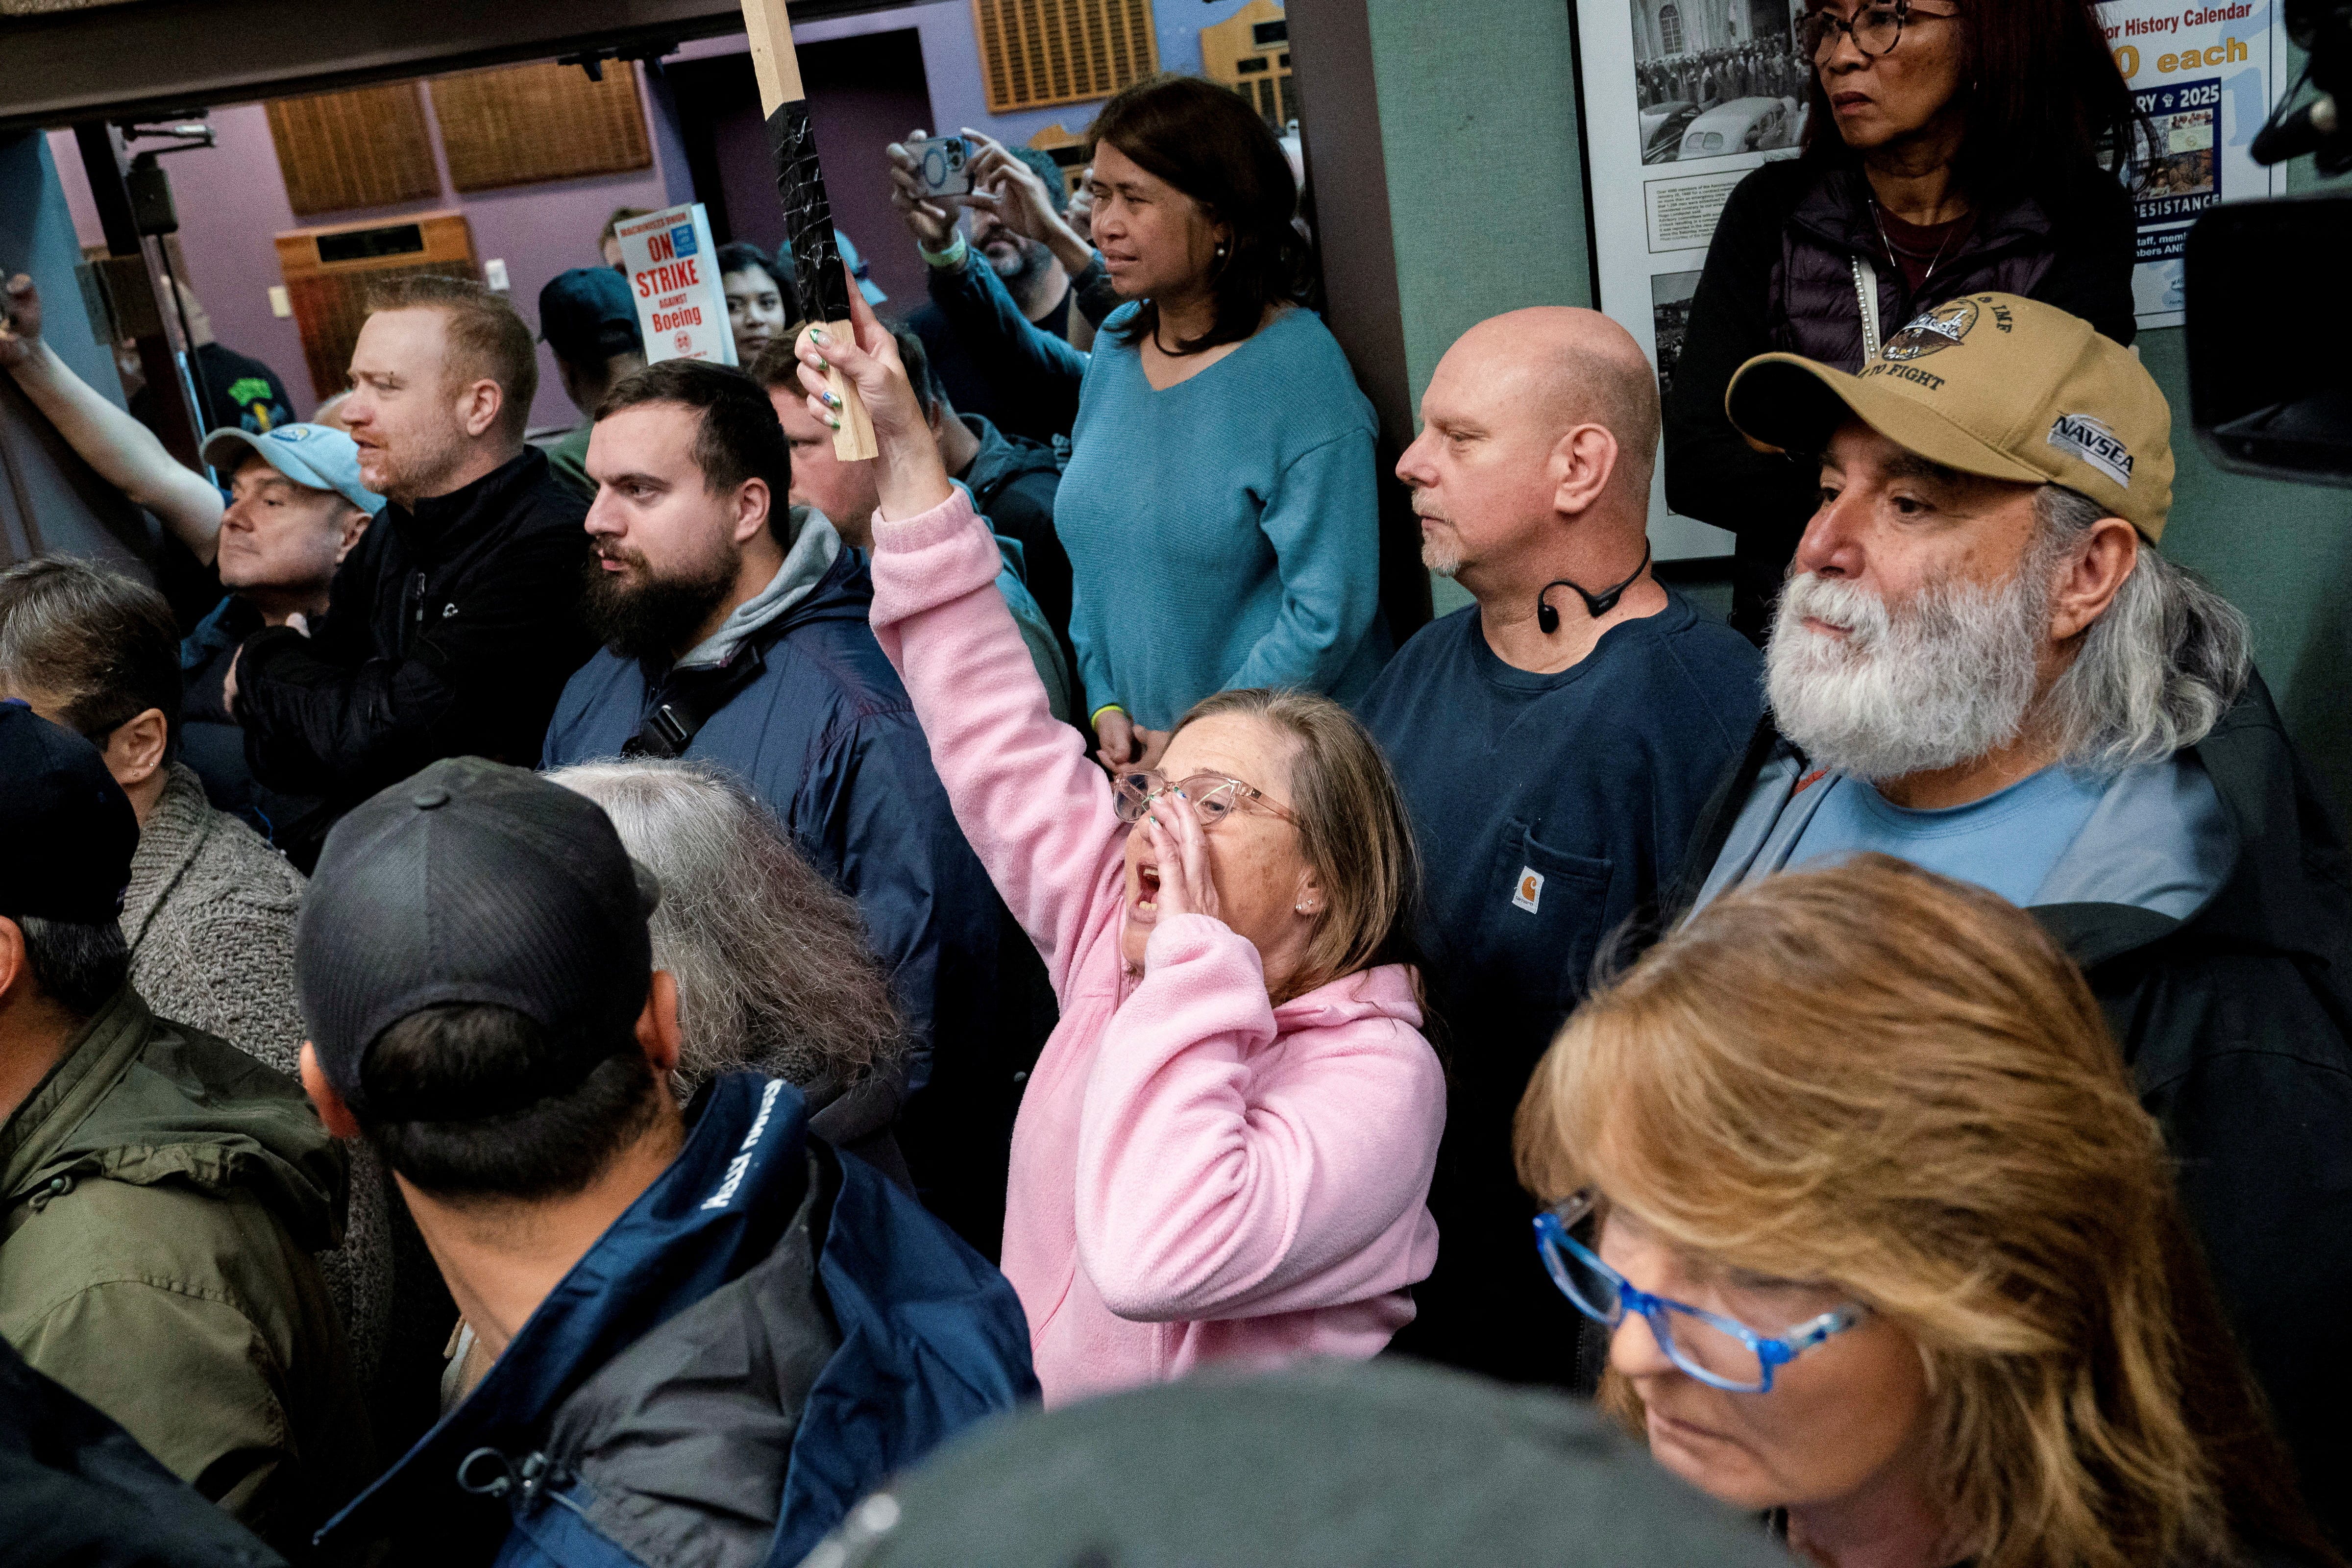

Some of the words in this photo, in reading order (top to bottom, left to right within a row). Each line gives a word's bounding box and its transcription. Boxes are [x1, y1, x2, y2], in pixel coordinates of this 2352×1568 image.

[2125, 16, 2179, 37] History
[2184, 2, 2252, 27] Calendar
[2157, 37, 2248, 73] each
[2180, 84, 2220, 108] 2025
[647, 232, 675, 263] ON
[2137, 236, 2156, 247] taff,
[636, 259, 700, 298] STRIKE
[652, 306, 702, 333] Boeing
[1886, 363, 1945, 391] FIGHT
[2051, 416, 2134, 473] NAVSEA
